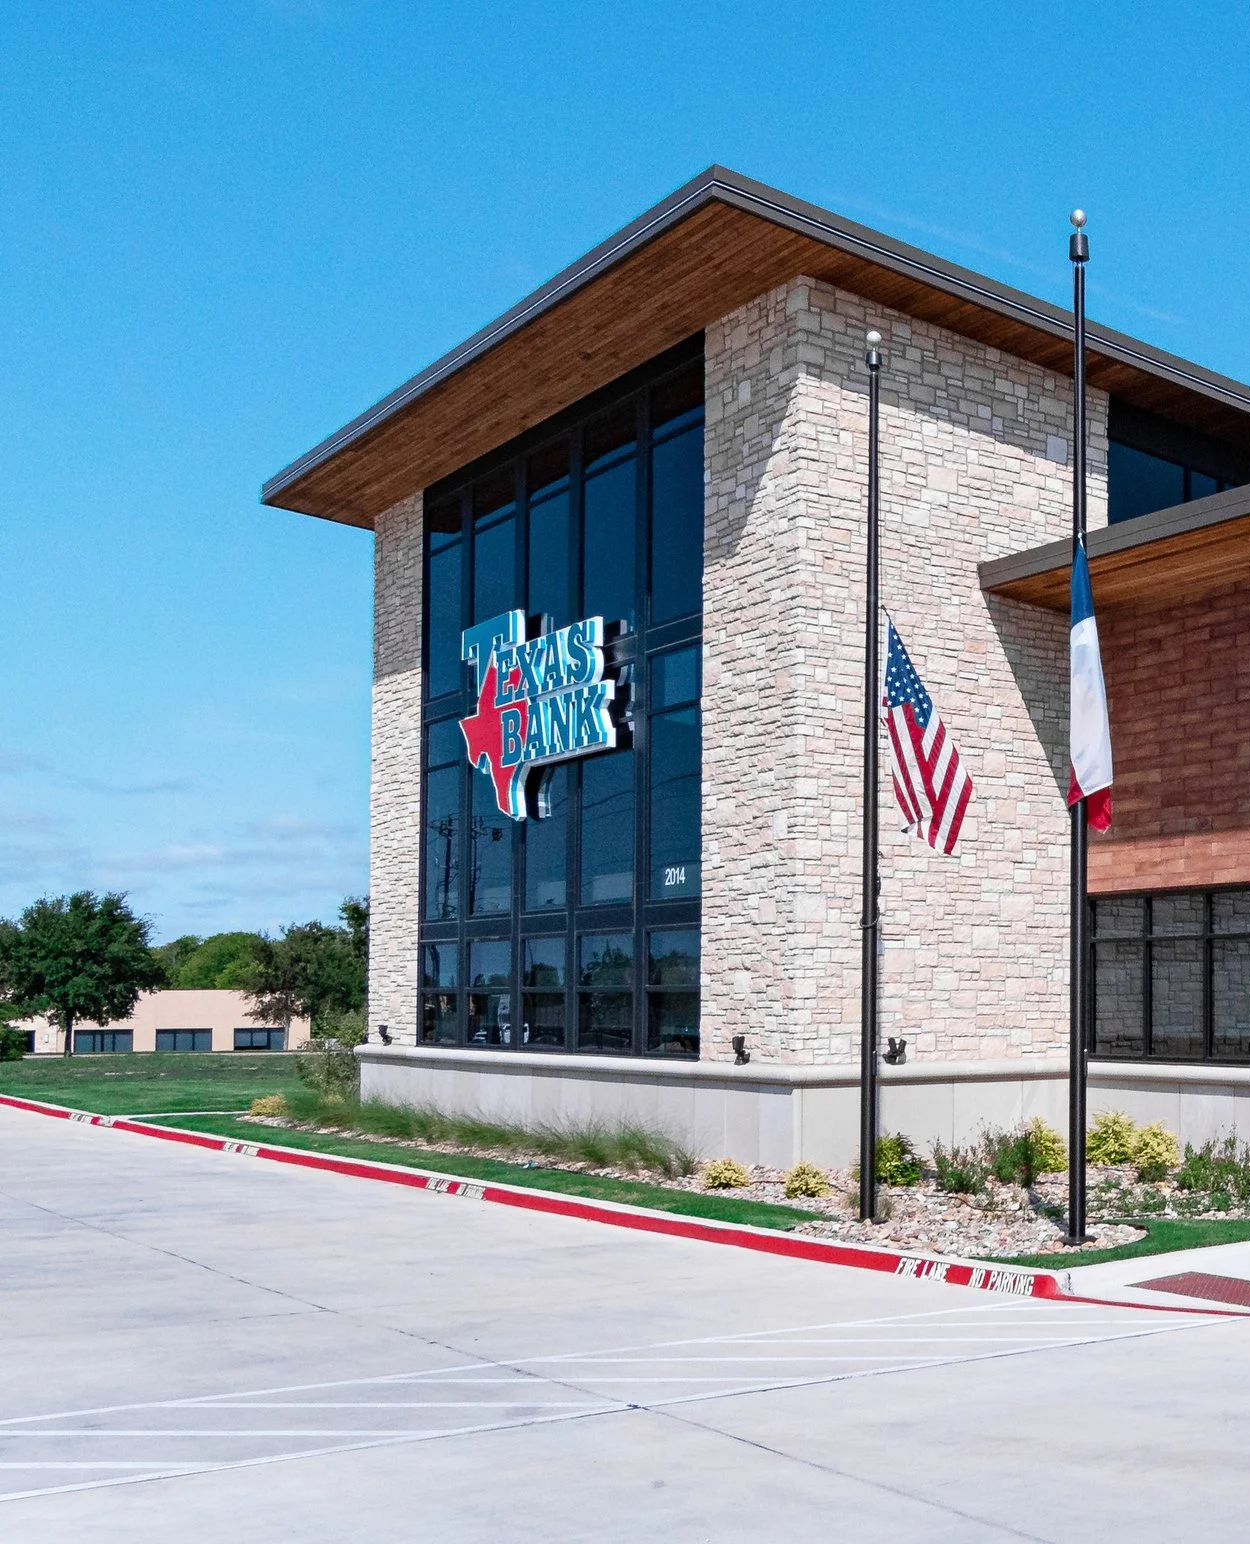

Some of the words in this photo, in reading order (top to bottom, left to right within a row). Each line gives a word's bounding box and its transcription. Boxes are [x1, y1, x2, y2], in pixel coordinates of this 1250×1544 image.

[462, 610, 601, 700] TEXAS
[501, 682, 609, 767] BANK
[665, 867, 685, 885] 2014
[895, 1258, 921, 1277] FIRE
[922, 1261, 950, 1282] LANE
[968, 1267, 986, 1288] NO
[986, 1270, 1034, 1296] PARKING
